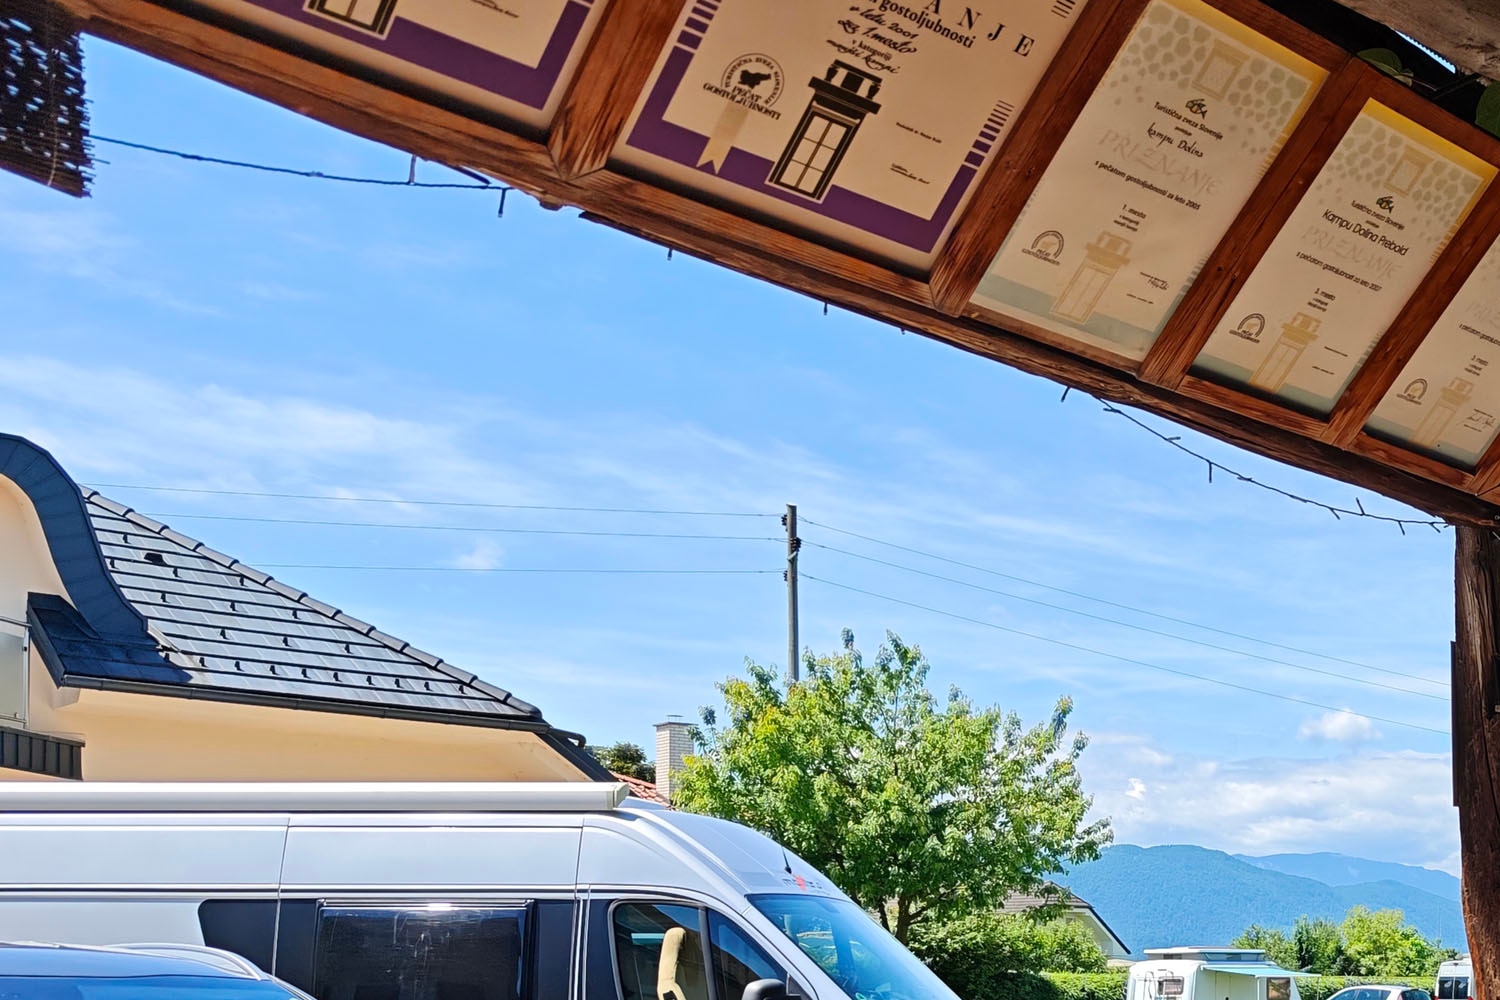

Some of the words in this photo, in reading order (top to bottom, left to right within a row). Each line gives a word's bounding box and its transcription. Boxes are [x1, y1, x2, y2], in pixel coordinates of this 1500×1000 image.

[878, 0, 976, 48] gostoljubnosti
[888, 23, 919, 39] 2001
[1322, 209, 1354, 231] Kampu
[1352, 223, 1378, 242] Dolina
[1377, 236, 1409, 256] Prebold
